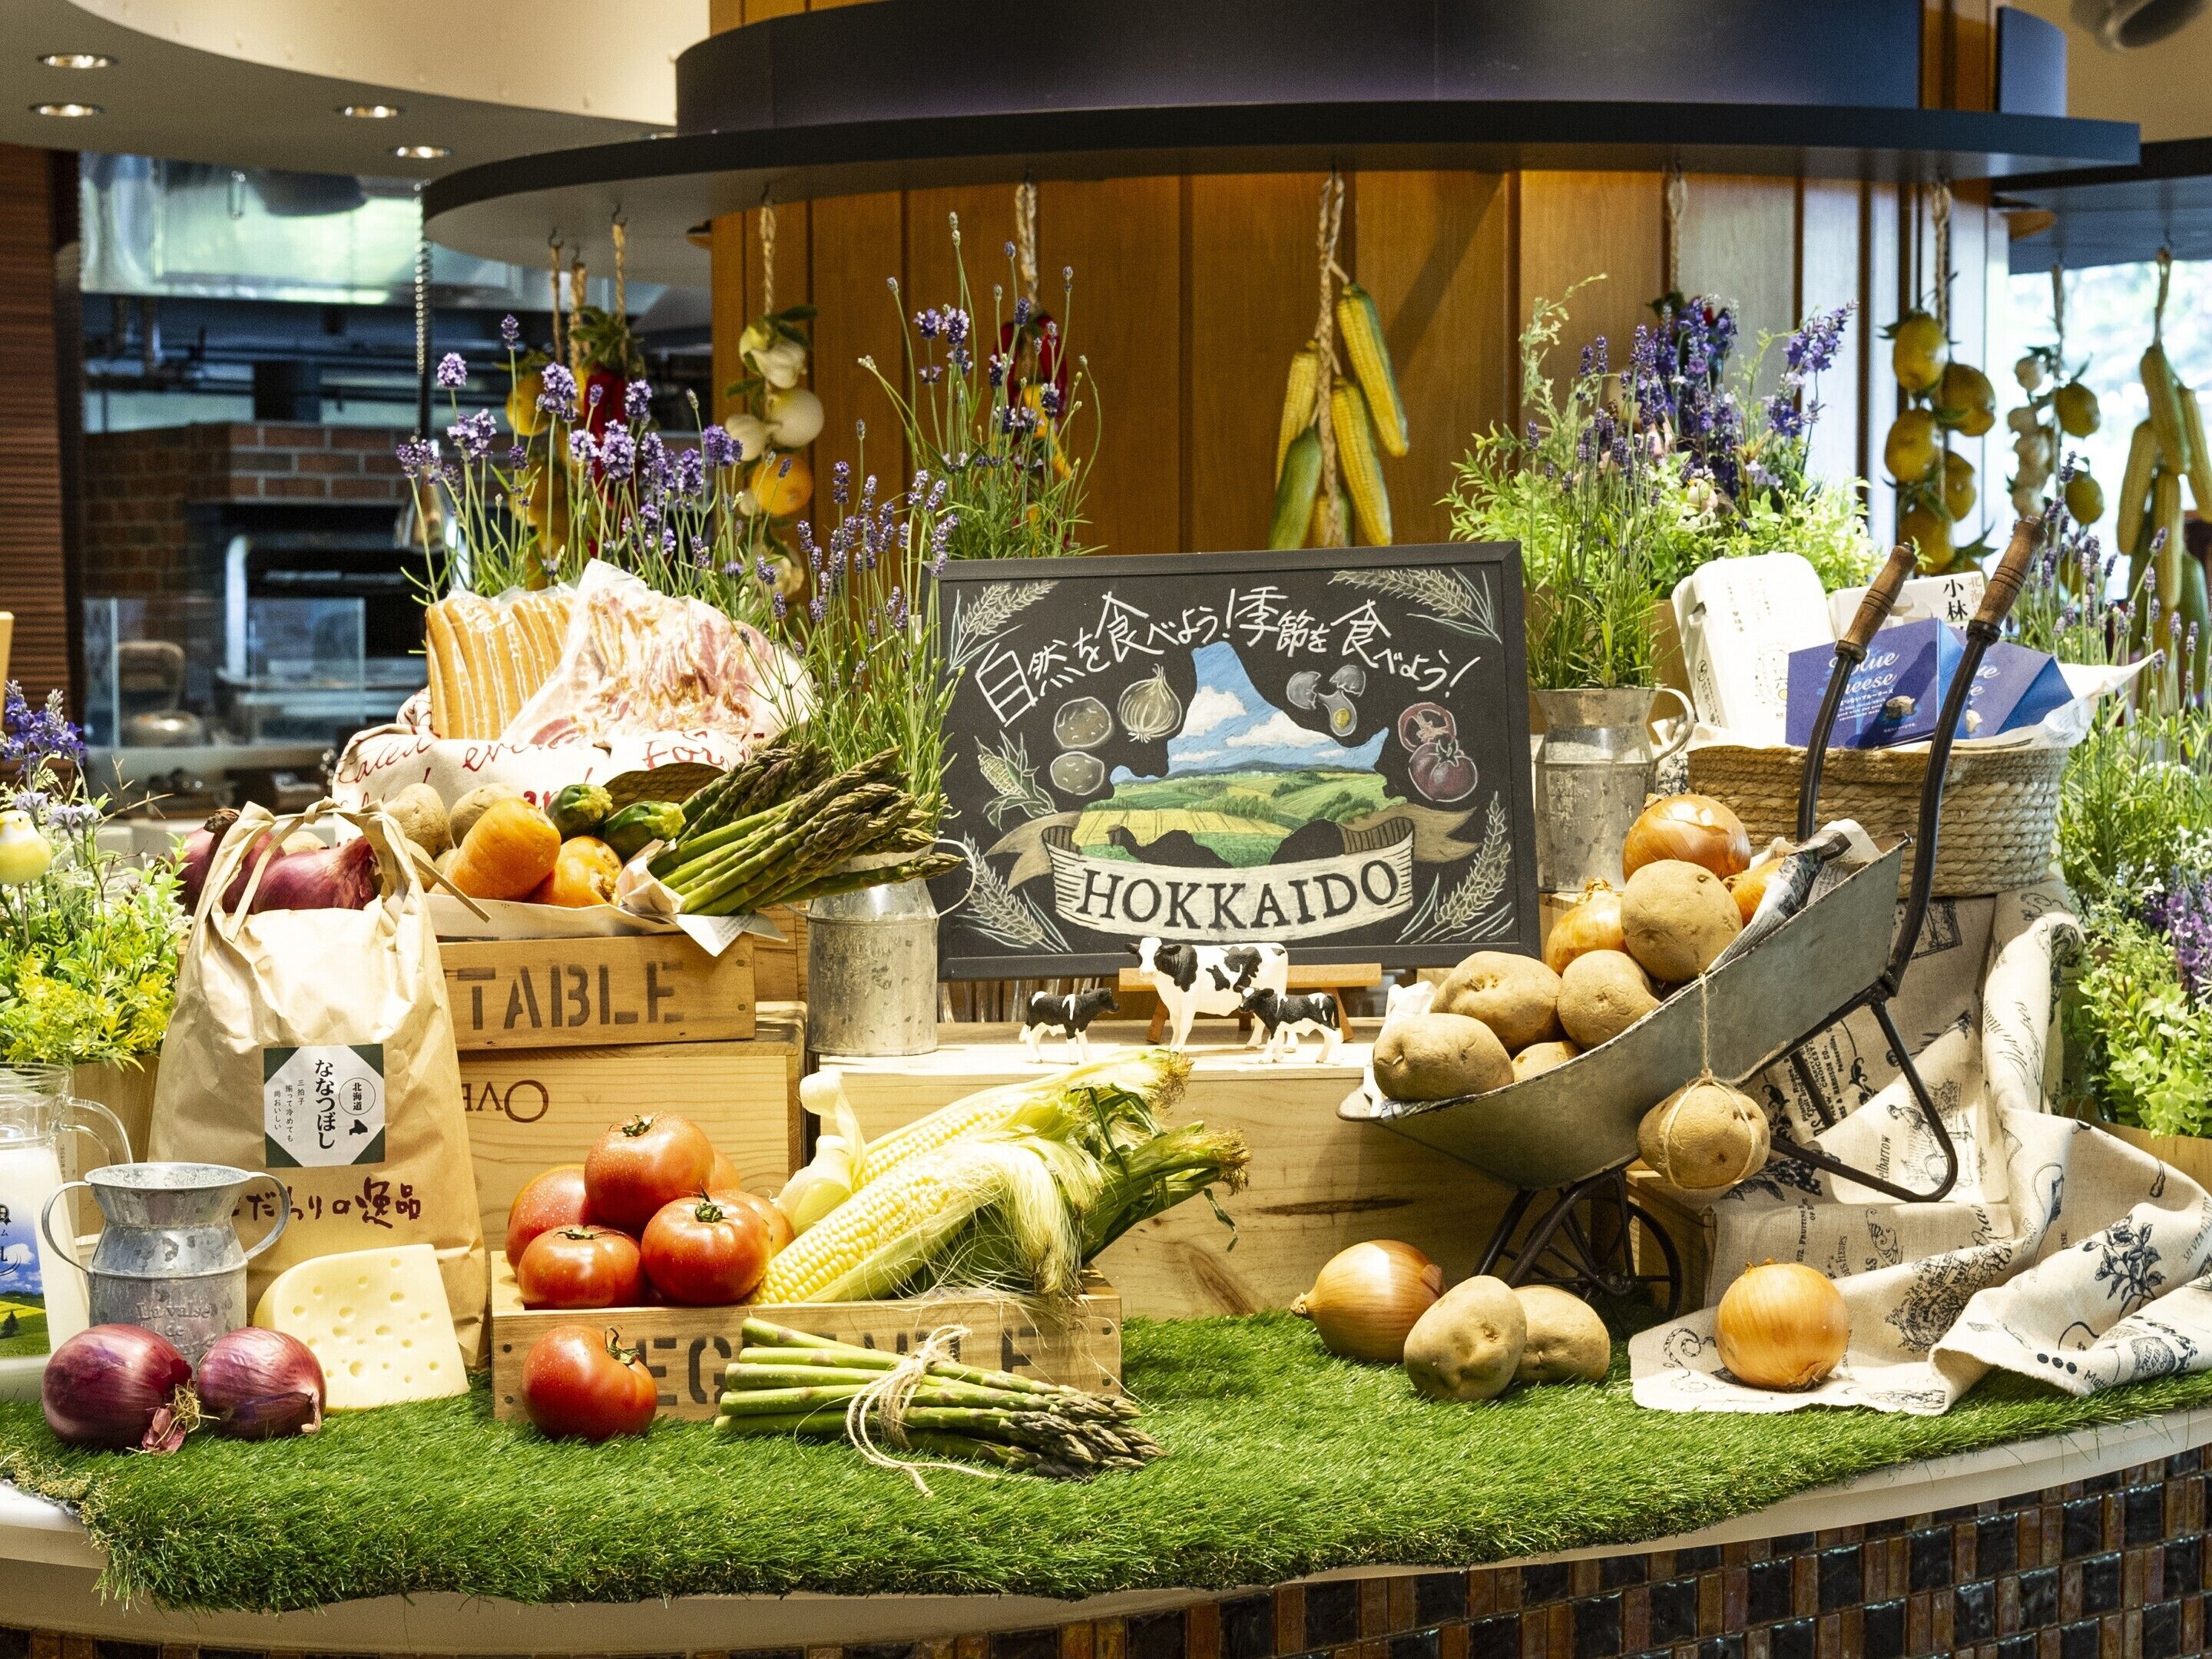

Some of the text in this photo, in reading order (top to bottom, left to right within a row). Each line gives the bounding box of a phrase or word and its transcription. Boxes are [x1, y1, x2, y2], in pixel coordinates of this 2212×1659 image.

[1943, 579, 1968, 630] 小林
[1845, 673, 1898, 694] eese
[1077, 859, 1399, 931] HOKKAIDO
[457, 960, 684, 1031] TABLE
[273, 1090, 282, 1130] 尚おいしい
[285, 1084, 293, 1142] 揃って冷めても
[315, 1059, 336, 1150] ななつぼし
[352, 1082, 363, 1111] 北海道
[1875, 1134, 1891, 1180] elbarrow
